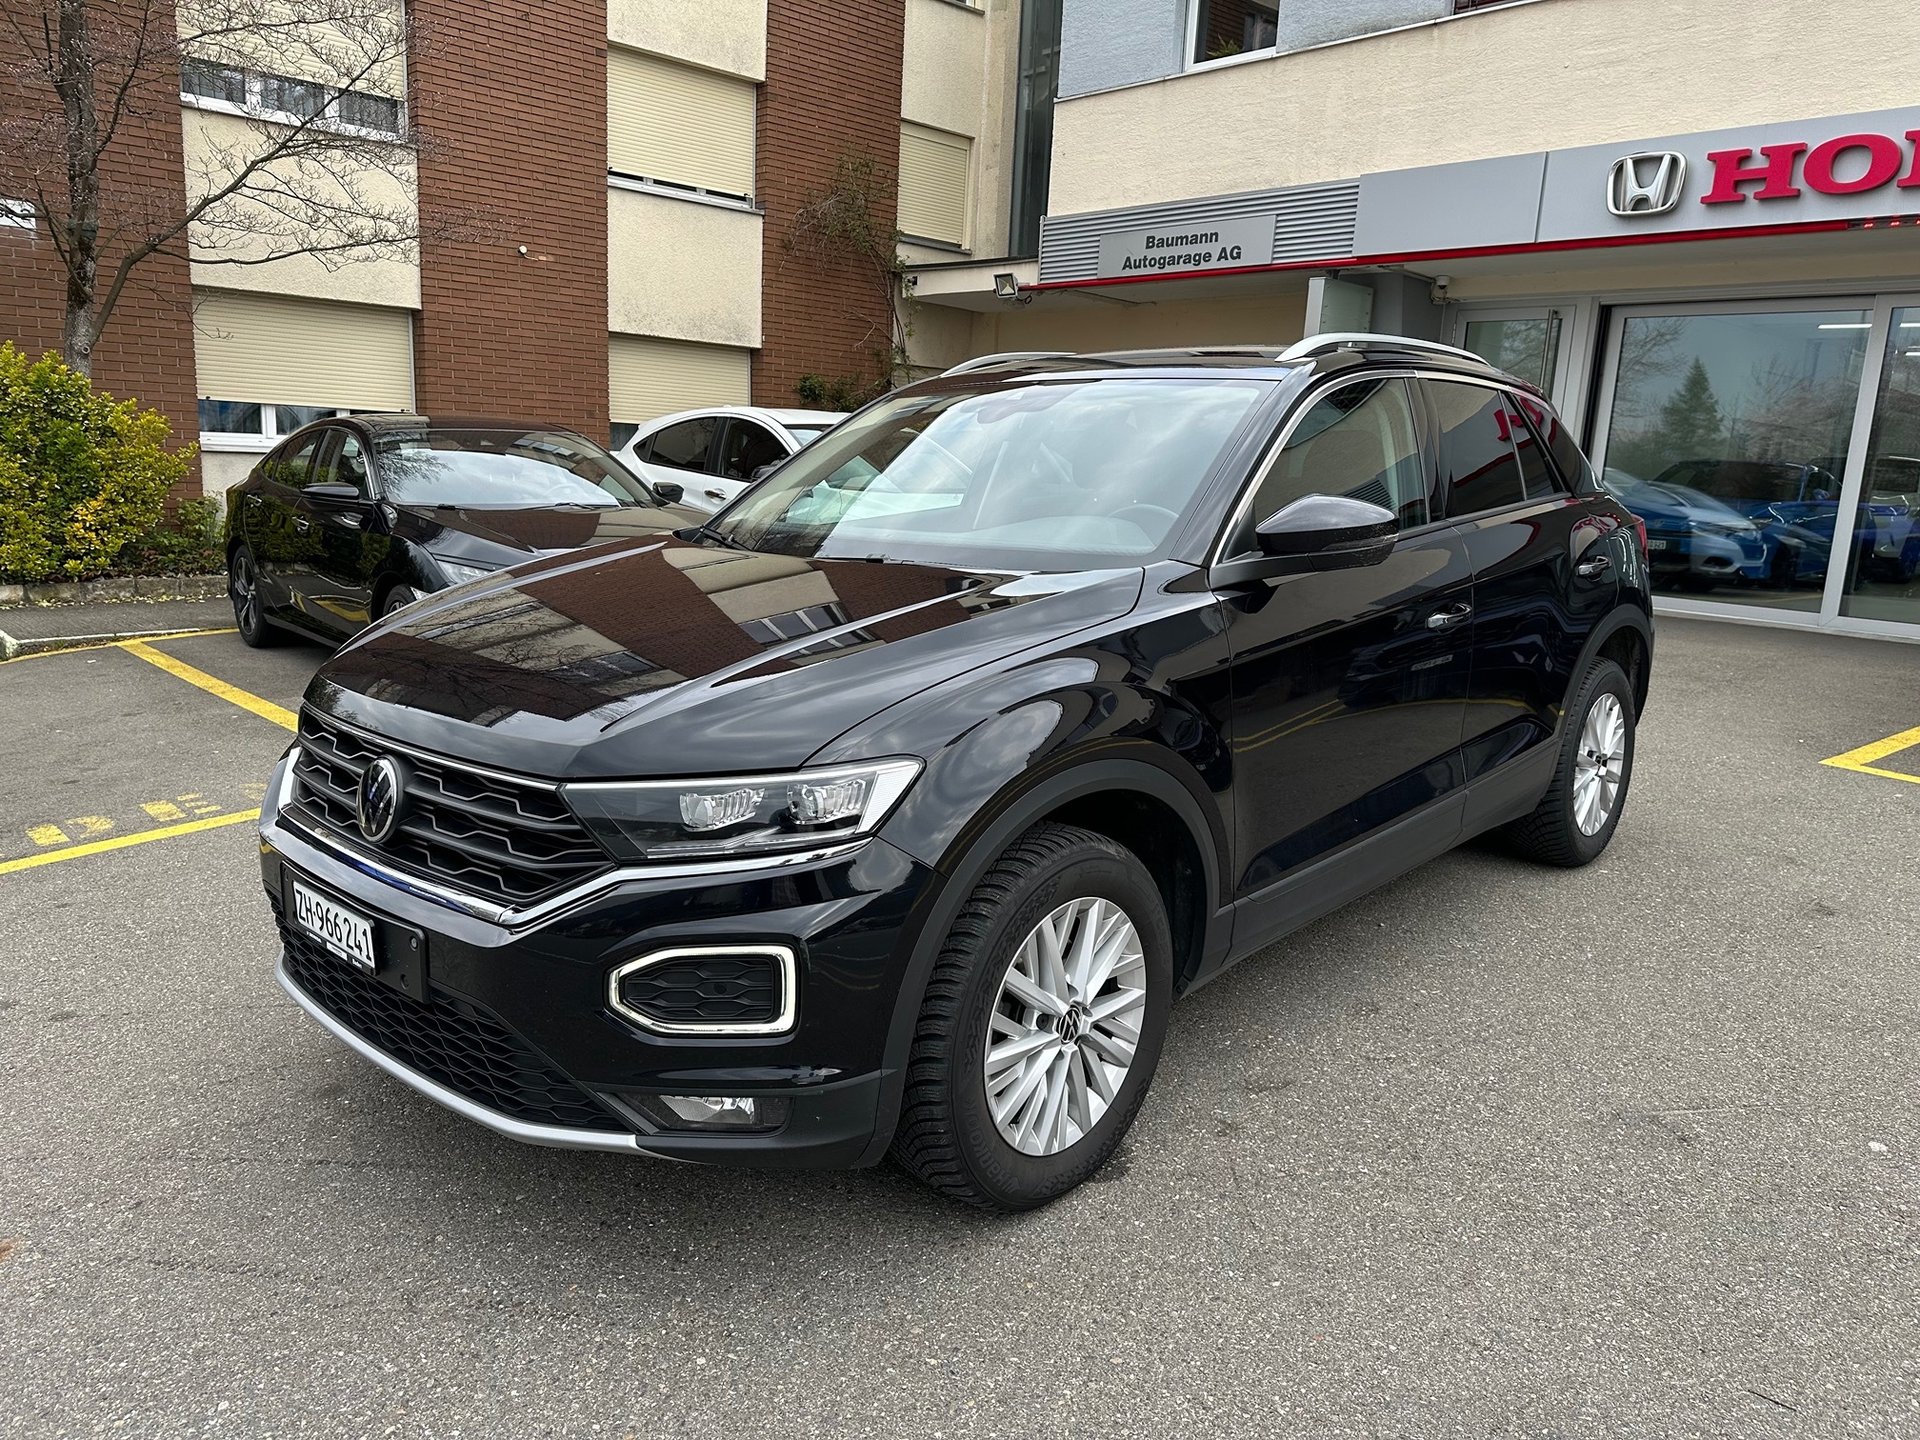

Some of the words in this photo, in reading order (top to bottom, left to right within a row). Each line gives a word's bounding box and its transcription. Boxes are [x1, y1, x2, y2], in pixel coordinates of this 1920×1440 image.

[1145, 231, 1219, 250] Baumann
[1121, 251, 1212, 271] Autogarage
[1216, 245, 1242, 262] AG
